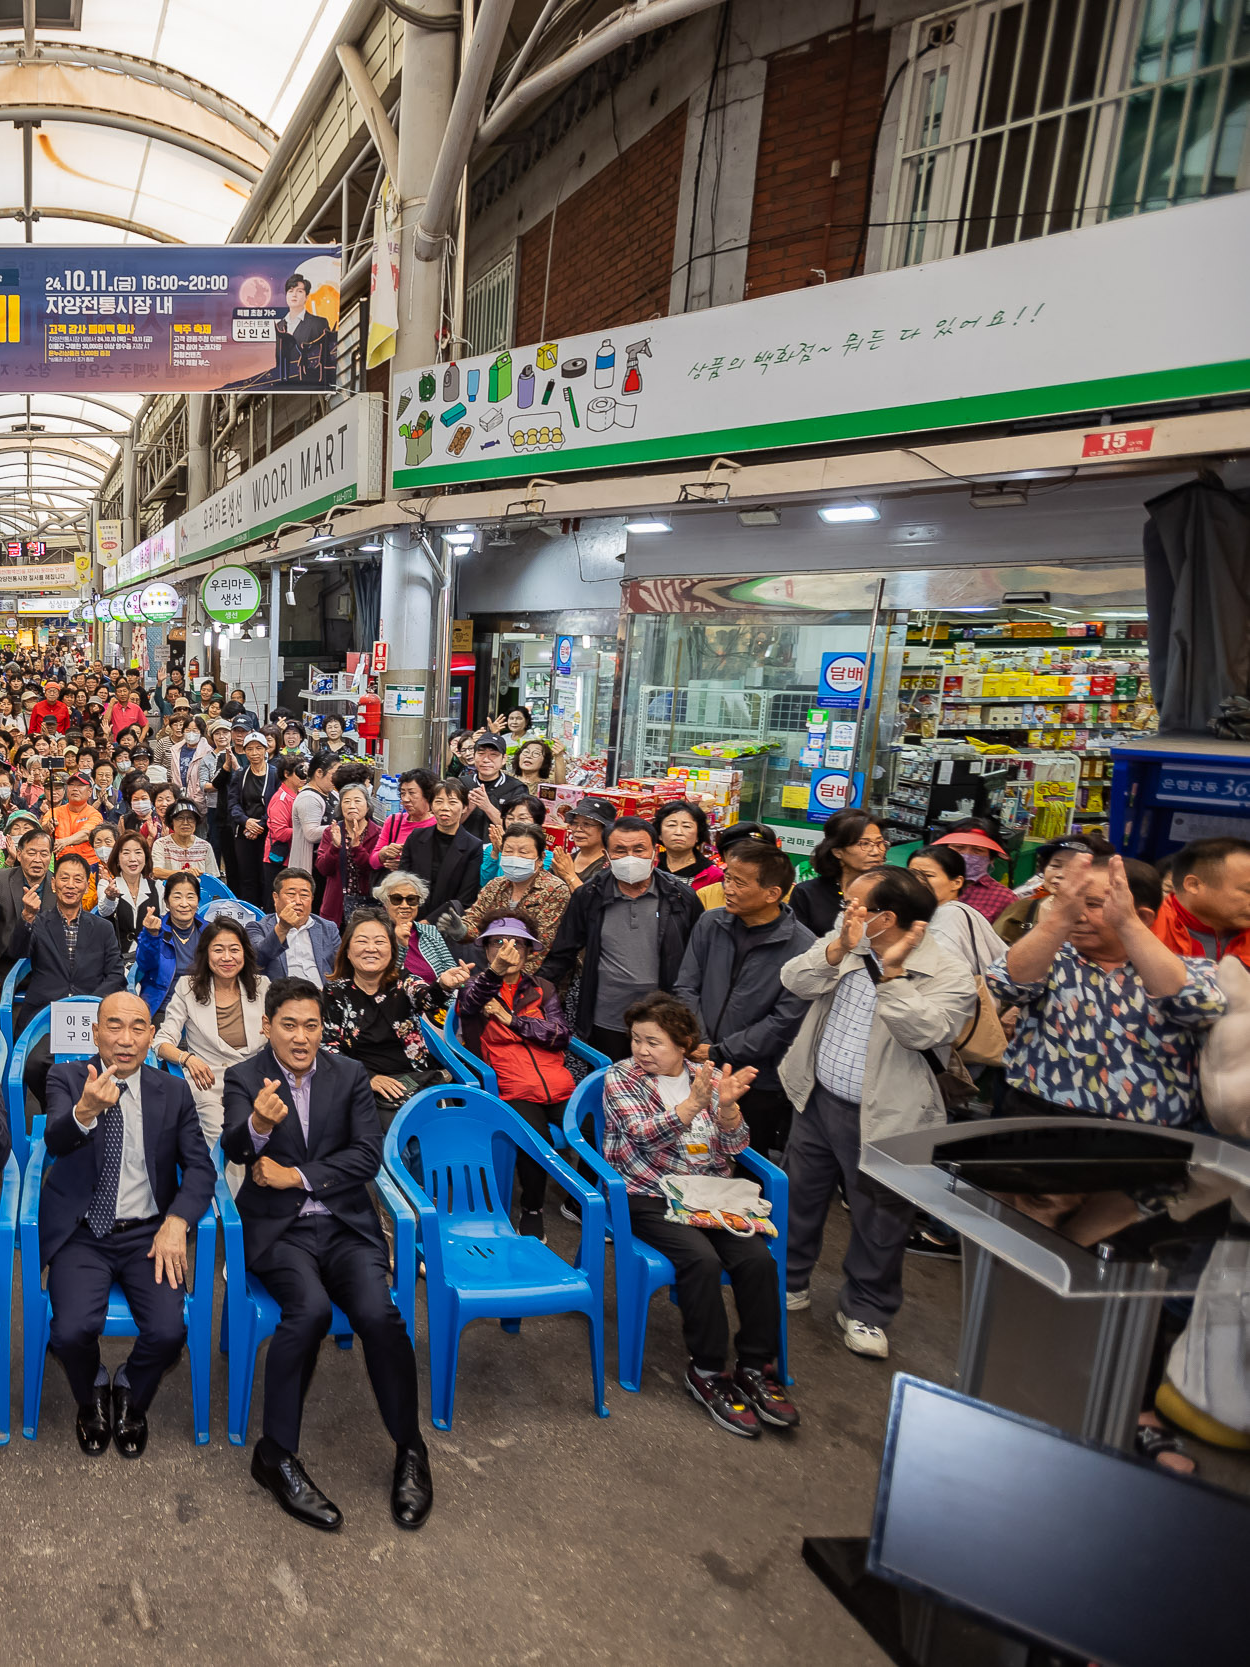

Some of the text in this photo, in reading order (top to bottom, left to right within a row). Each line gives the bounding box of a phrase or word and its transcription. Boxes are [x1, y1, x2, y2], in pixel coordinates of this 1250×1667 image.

[141, 275, 229, 291] 16:00~20:00
[45, 296, 173, 316] 자양전통시장 내
[264, 309, 276, 317] 가수
[49, 324, 67, 335] 고객
[68, 324, 87, 335] 감사
[116, 324, 136, 335] 행사
[237, 320, 256, 328] 미스터
[688, 357, 745, 381] 상품의
[842, 329, 886, 356] 뭐든
[899, 328, 921, 341] 다
[1101, 432, 1127, 450] 15
[252, 424, 348, 512] WOORI MART
[210, 579, 253, 592] 우리마트
[221, 593, 242, 606] 생선
[225, 611, 238, 619] 생선
[830, 667, 864, 681] 담배
[1162, 778, 1250, 797] 은행공동 36
